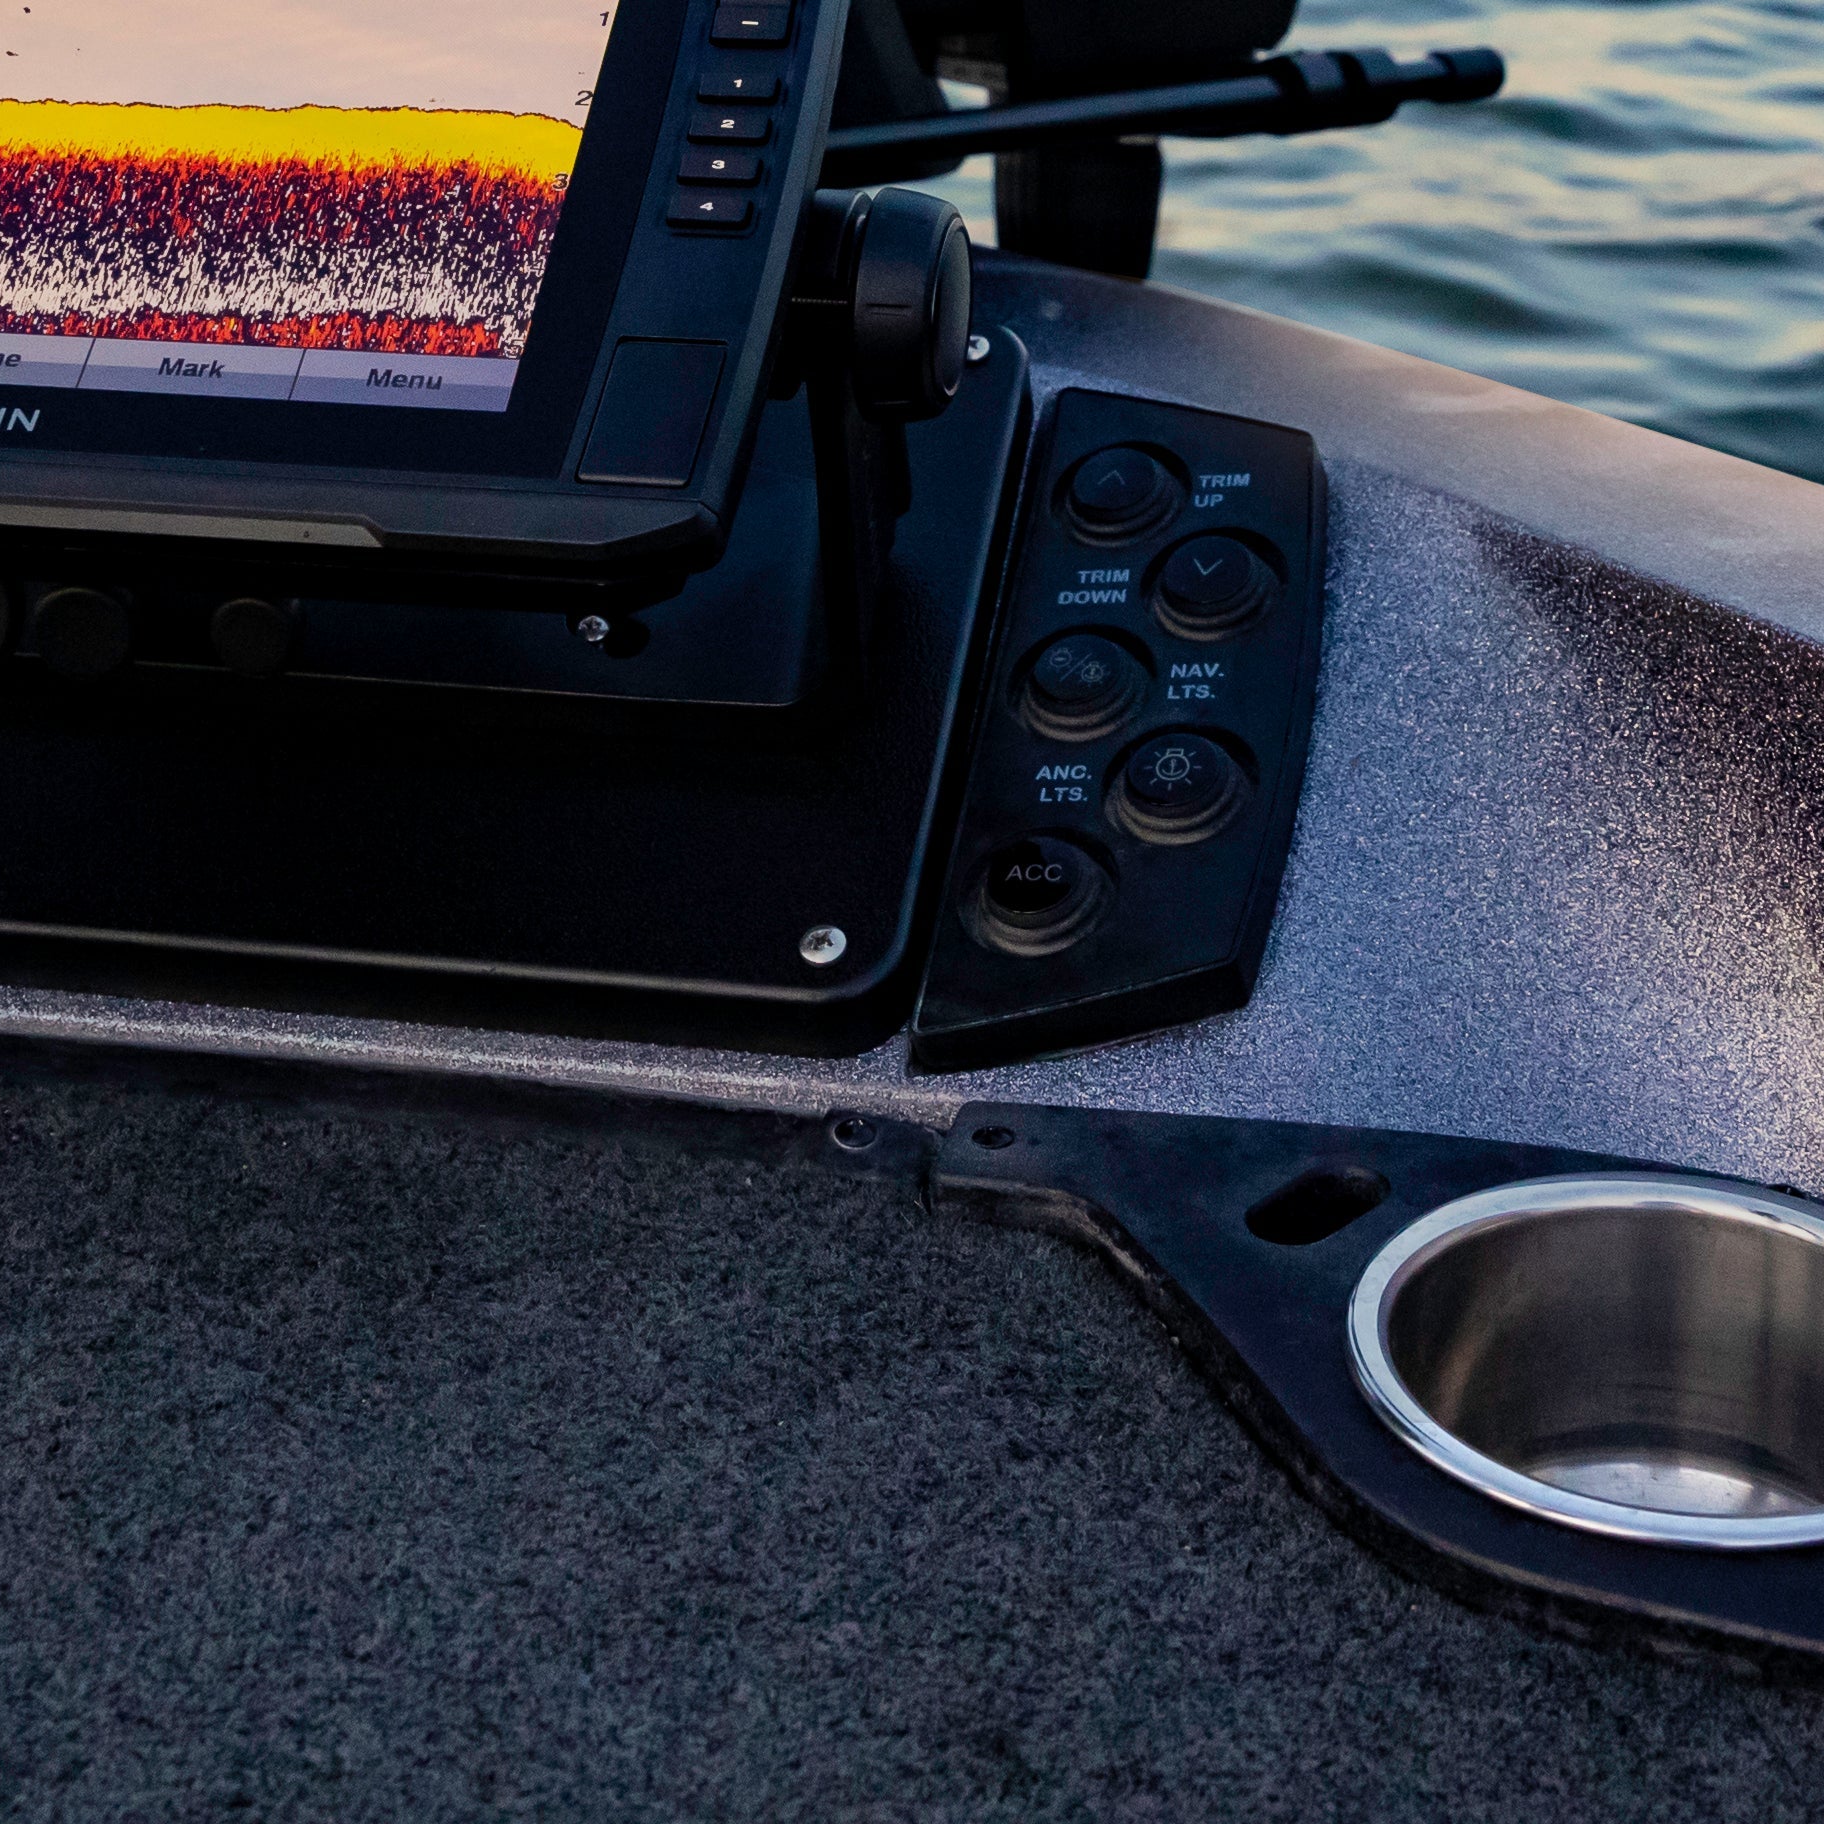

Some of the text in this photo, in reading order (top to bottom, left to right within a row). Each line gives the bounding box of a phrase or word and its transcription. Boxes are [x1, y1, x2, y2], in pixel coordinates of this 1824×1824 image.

[599, 11, 610, 26] 1
[733, 79, 743, 88] 1
[575, 90, 593, 106] 2
[720, 119, 735, 129] 2
[711, 160, 725, 169] 3
[552, 173, 568, 189] 3
[700, 202, 714, 211] 4
[158, 357, 226, 378] Mark
[366, 369, 443, 390] Menu
[1198, 473, 1251, 488] TRIM
[1193, 493, 1224, 508] UP
[1078, 569, 1130, 584] TRIM
[1057, 589, 1127, 605] DOWN
[1170, 662, 1225, 678] NAV.
[1166, 684, 1216, 700] LTS.
[1035, 764, 1092, 781] ANC.
[1039, 787, 1088, 802] LTS.
[1005, 863, 1063, 883] ACC
